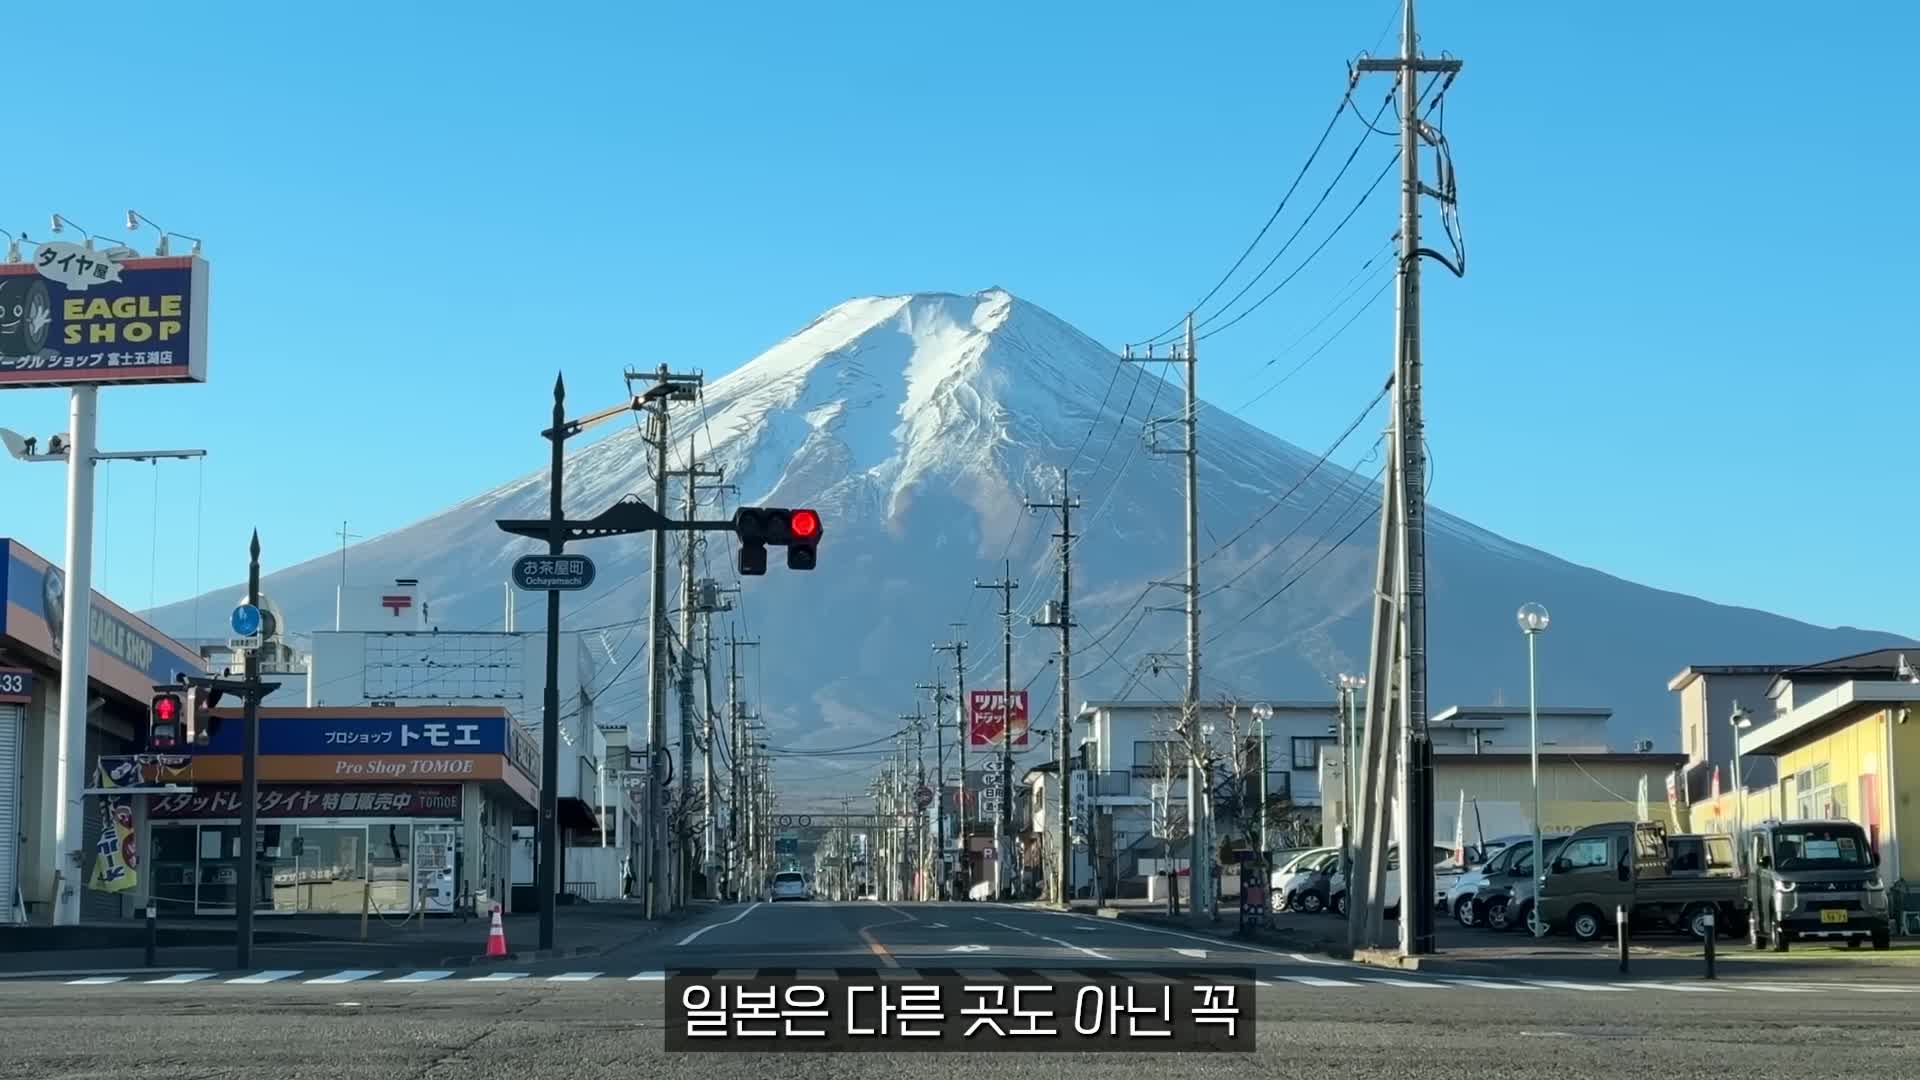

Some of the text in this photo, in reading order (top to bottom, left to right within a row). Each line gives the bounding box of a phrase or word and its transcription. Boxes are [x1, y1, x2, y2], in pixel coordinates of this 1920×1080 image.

[38, 247, 109, 280] タイヤ屋
[63, 295, 183, 320] EAGLE
[63, 321, 182, 345] SHOP
[108, 351, 173, 366] 富士五湖店
[524, 561, 584, 575] お茶屋町
[526, 576, 582, 586] Ochayamachi
[91, 608, 125, 656] EAGLE
[324, 723, 481, 747] プロショップ トモエ
[335, 760, 475, 777] Pro Shop TOMOE
